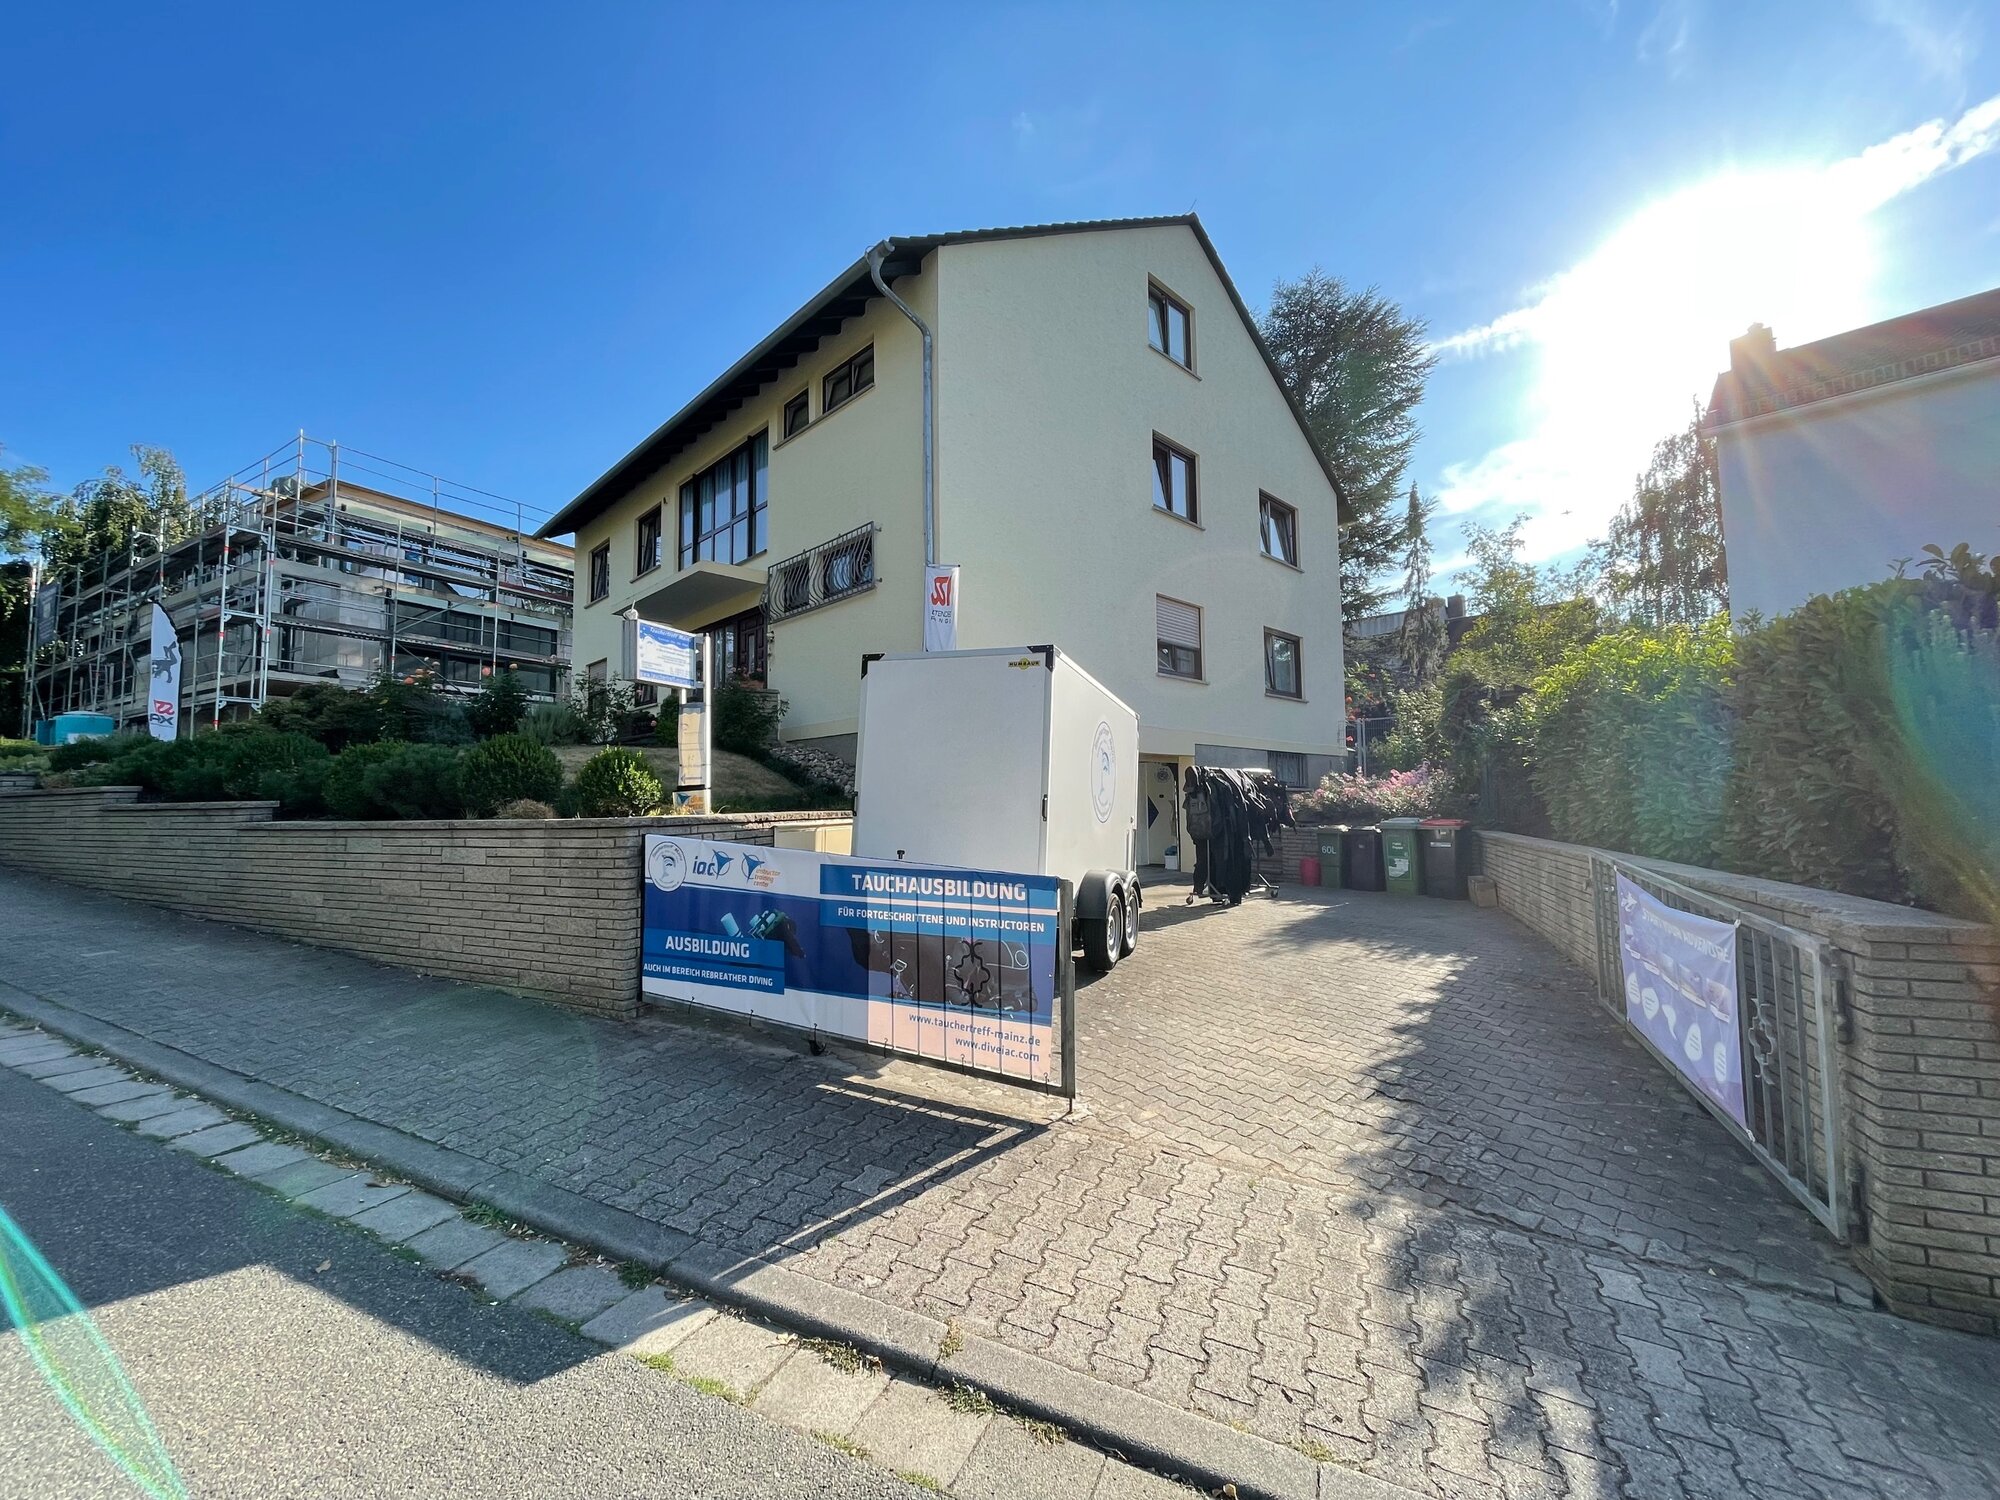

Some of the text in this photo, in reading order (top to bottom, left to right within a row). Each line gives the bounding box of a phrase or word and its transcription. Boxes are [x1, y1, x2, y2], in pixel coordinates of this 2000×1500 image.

[851, 873, 1026, 901] TAUCHAUSBILDUNG
[837, 907, 1045, 933] FÜR FORTGESCHRITTENE UND INSTRUCTOREN
[665, 935, 750, 958] AUSBILDUNG
[643, 962, 773, 987] AUCH IM BEREICH REBREATHER DIVING
[908, 1012, 1041, 1047] www.tauchertreff-mainz.de
[954, 1036, 1040, 1062] www.diveiac.com
